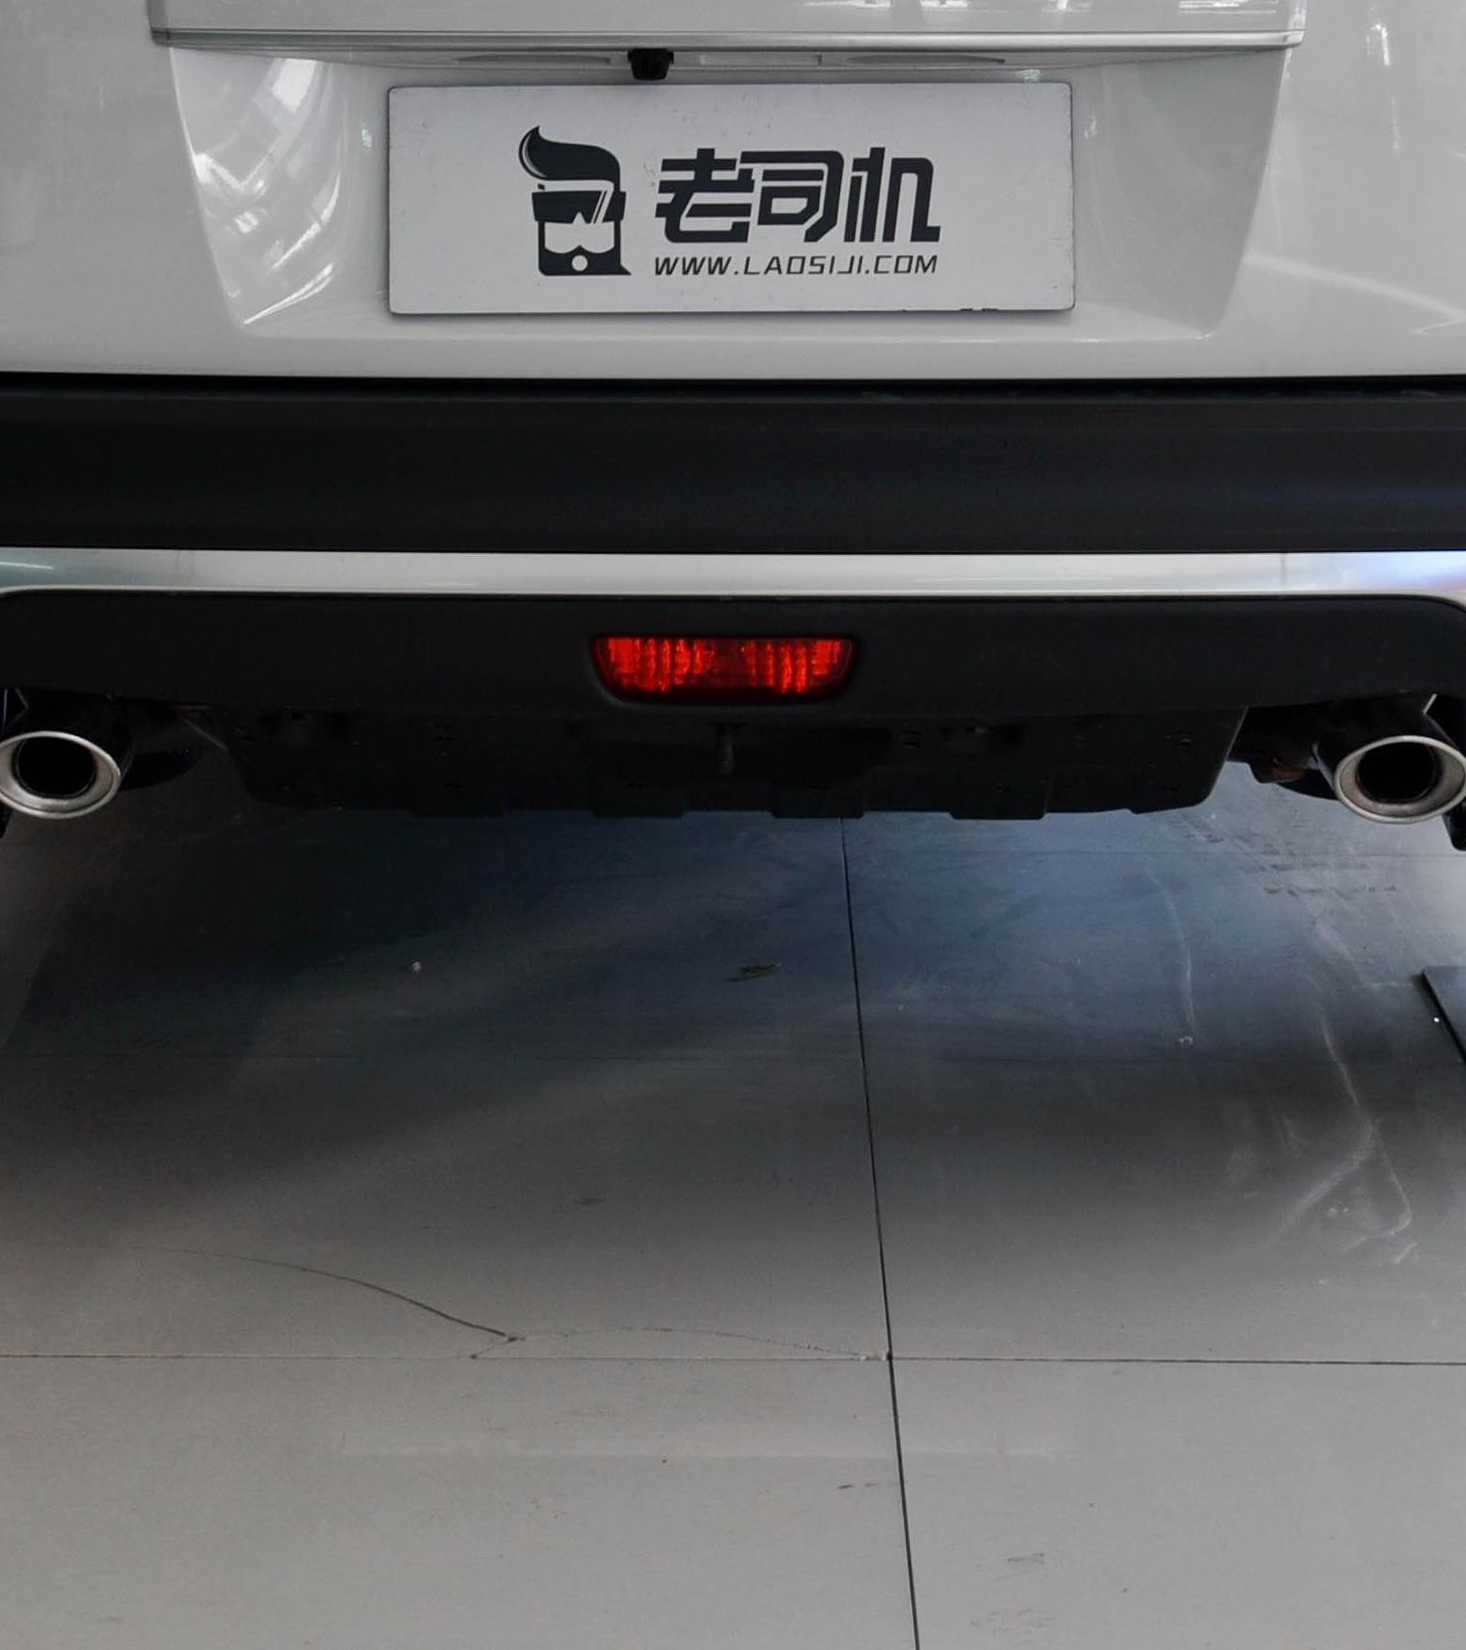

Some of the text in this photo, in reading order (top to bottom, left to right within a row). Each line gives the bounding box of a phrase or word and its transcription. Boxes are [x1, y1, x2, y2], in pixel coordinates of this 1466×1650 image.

[654, 147, 942, 244] 老司机
[654, 254, 938, 276] WWW.LAOSIJI.COM
